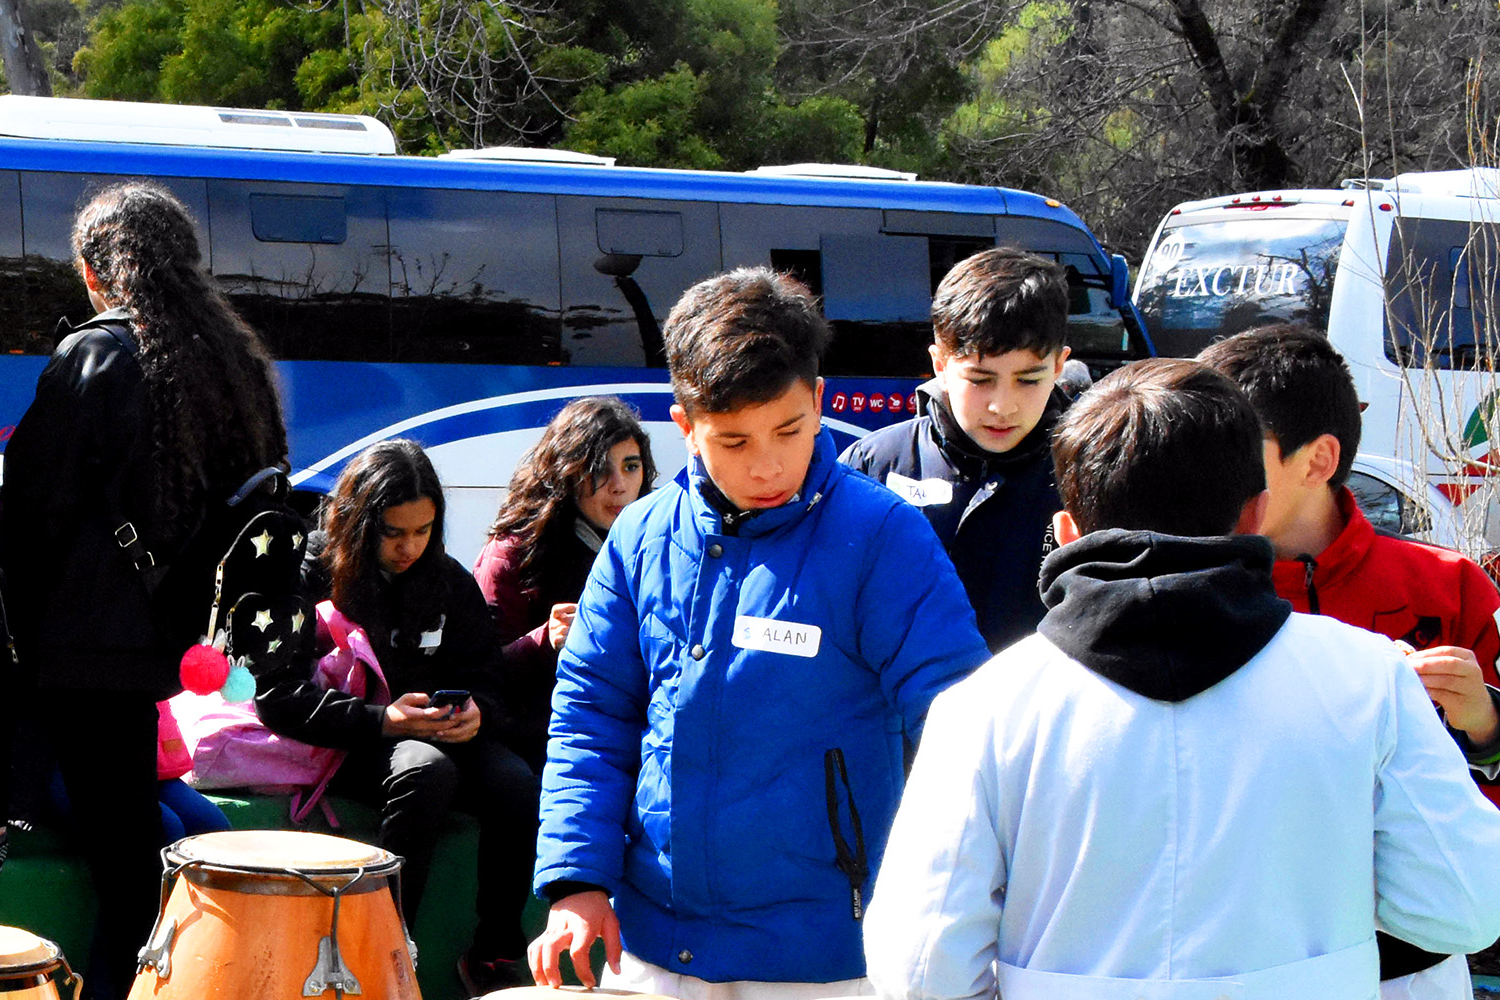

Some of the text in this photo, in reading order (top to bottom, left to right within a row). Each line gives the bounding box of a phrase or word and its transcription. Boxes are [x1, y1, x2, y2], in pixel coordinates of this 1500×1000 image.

[1161, 242, 1180, 261] 90
[1172, 264, 1299, 298] EXCTUR
[852, 397, 864, 406] TV
[870, 399, 884, 408] WC
[763, 627, 807, 645] ALAN
